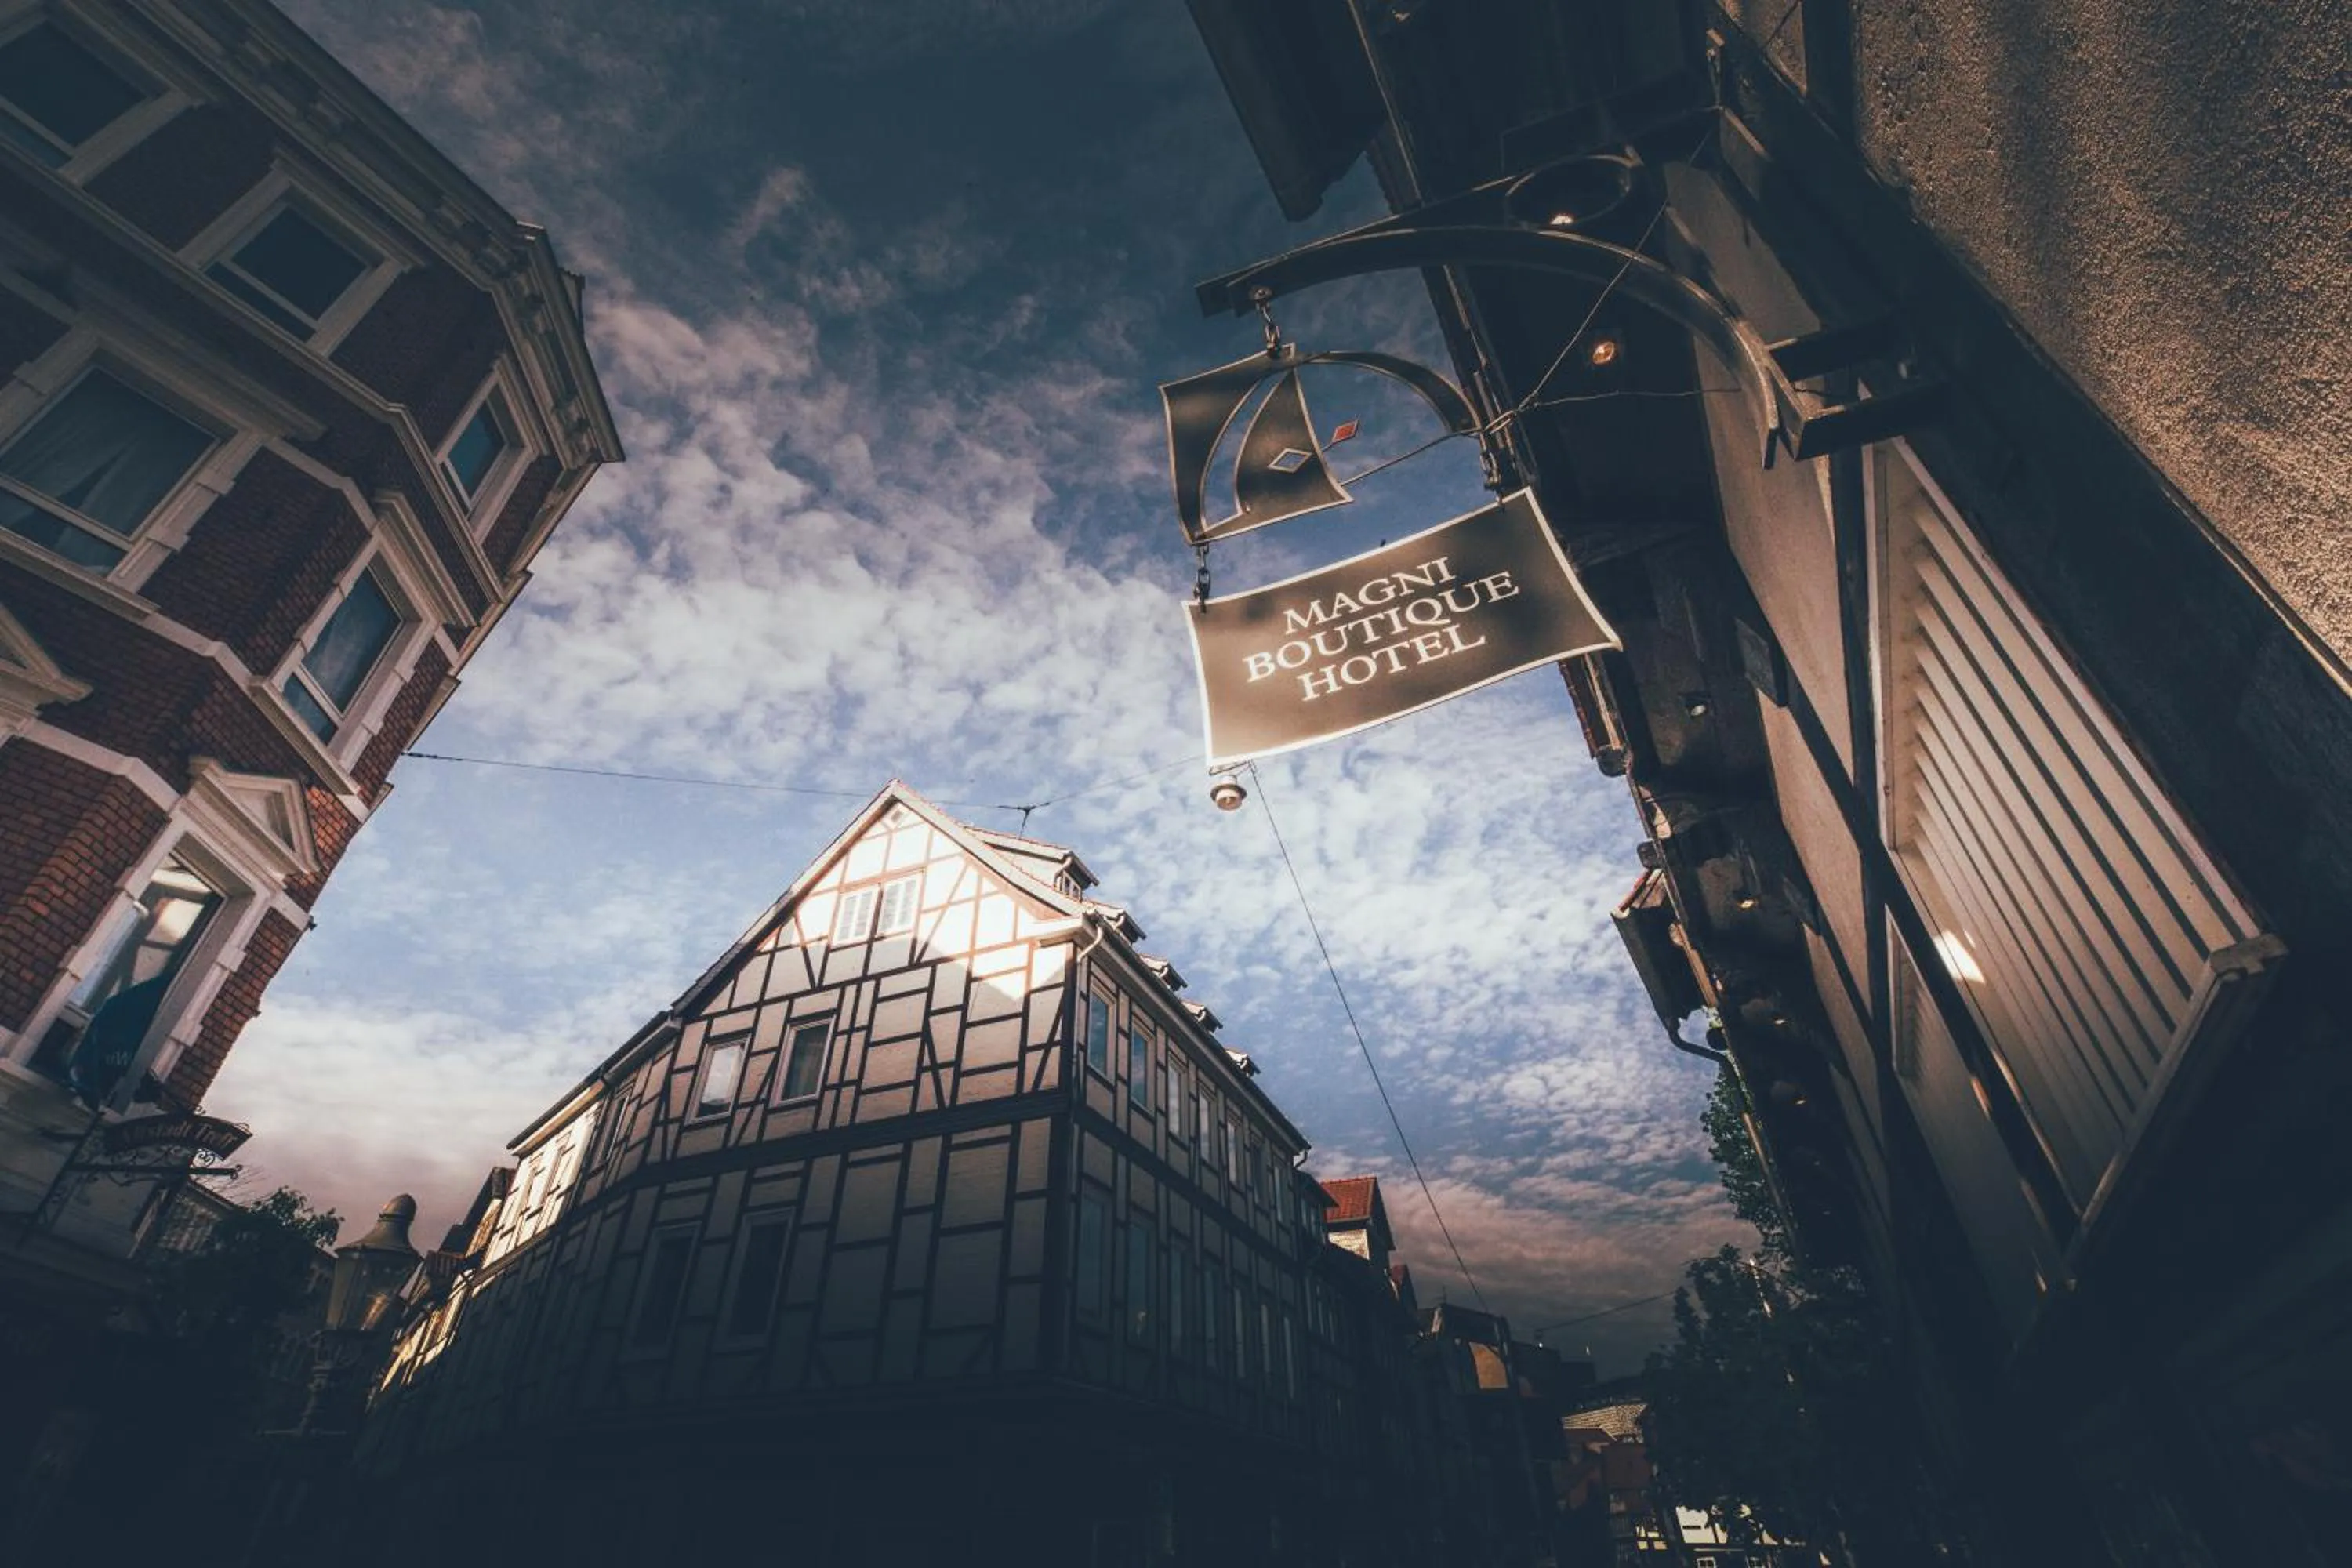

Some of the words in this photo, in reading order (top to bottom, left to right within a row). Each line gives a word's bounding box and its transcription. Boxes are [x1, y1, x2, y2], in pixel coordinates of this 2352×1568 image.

[1243, 571, 1520, 683] BOUTIQUE
[1283, 557, 1457, 635] MAGNI
[1296, 624, 1486, 702] HOTEL
